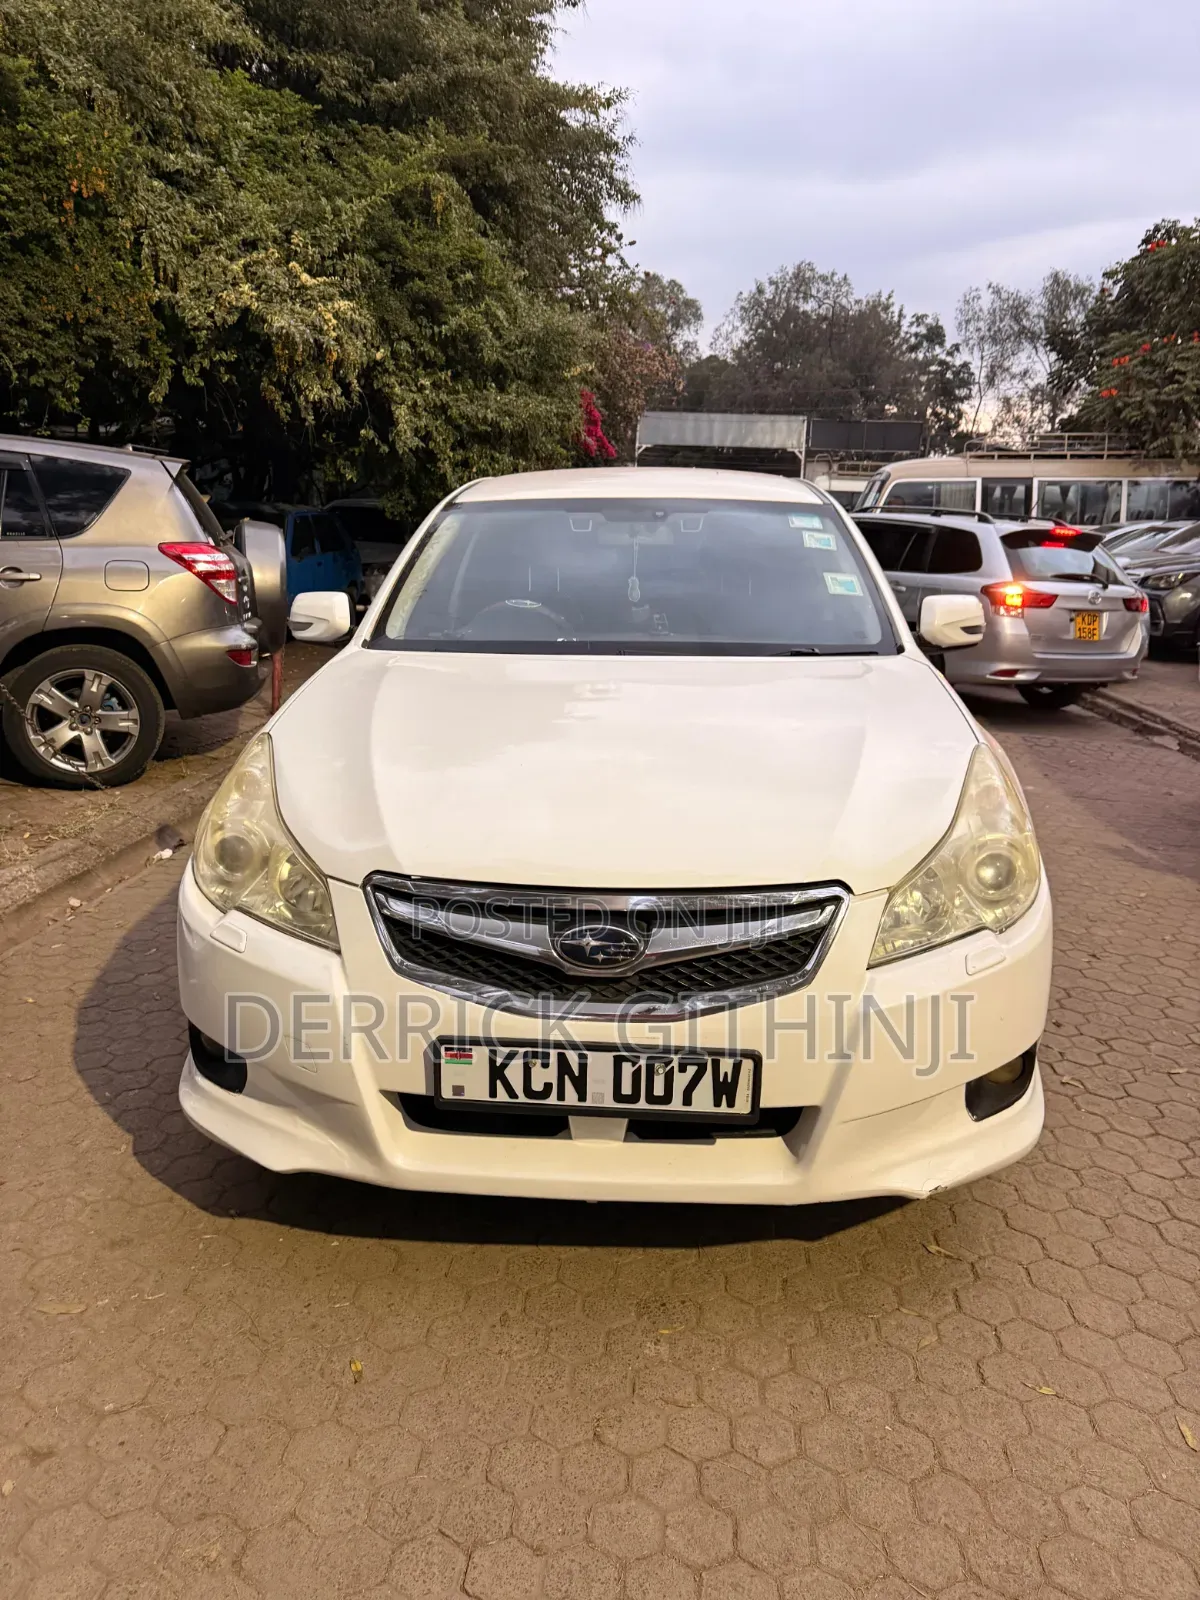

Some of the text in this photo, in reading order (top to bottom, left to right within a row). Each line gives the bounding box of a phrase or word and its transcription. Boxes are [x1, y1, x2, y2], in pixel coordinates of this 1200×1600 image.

[1081, 614, 1098, 626] KDP
[1078, 627, 1097, 639] 158F
[488, 1048, 588, 1103] KCN
[612, 1054, 743, 1109] 007W
